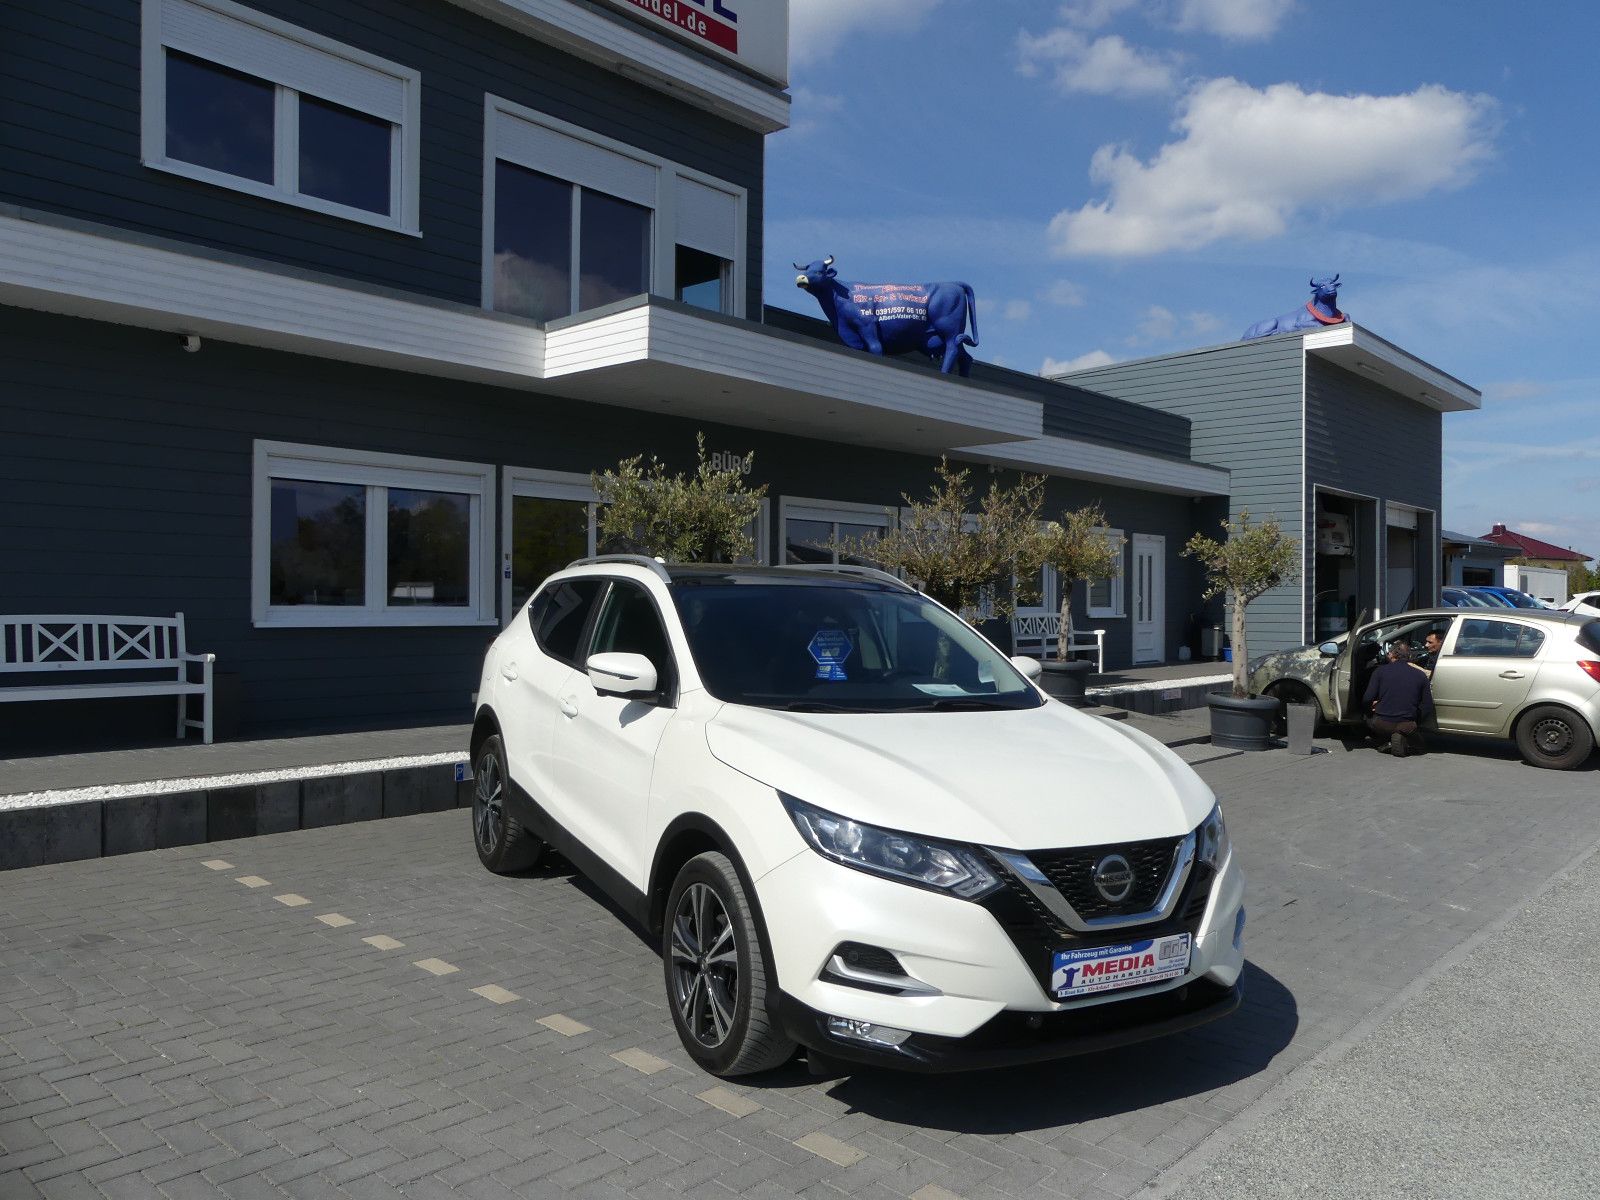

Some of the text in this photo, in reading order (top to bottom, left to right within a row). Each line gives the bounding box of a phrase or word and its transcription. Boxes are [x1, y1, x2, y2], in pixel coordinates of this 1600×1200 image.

[875, 306, 905, 316] 0391/597
[711, 450, 752, 475] BÜRO
[1070, 951, 1098, 960] Fahrzeug
[1109, 945, 1132, 954] Garantie
[1081, 953, 1155, 977] MEDIA
[1081, 968, 1153, 985] AUTOHANDEL
